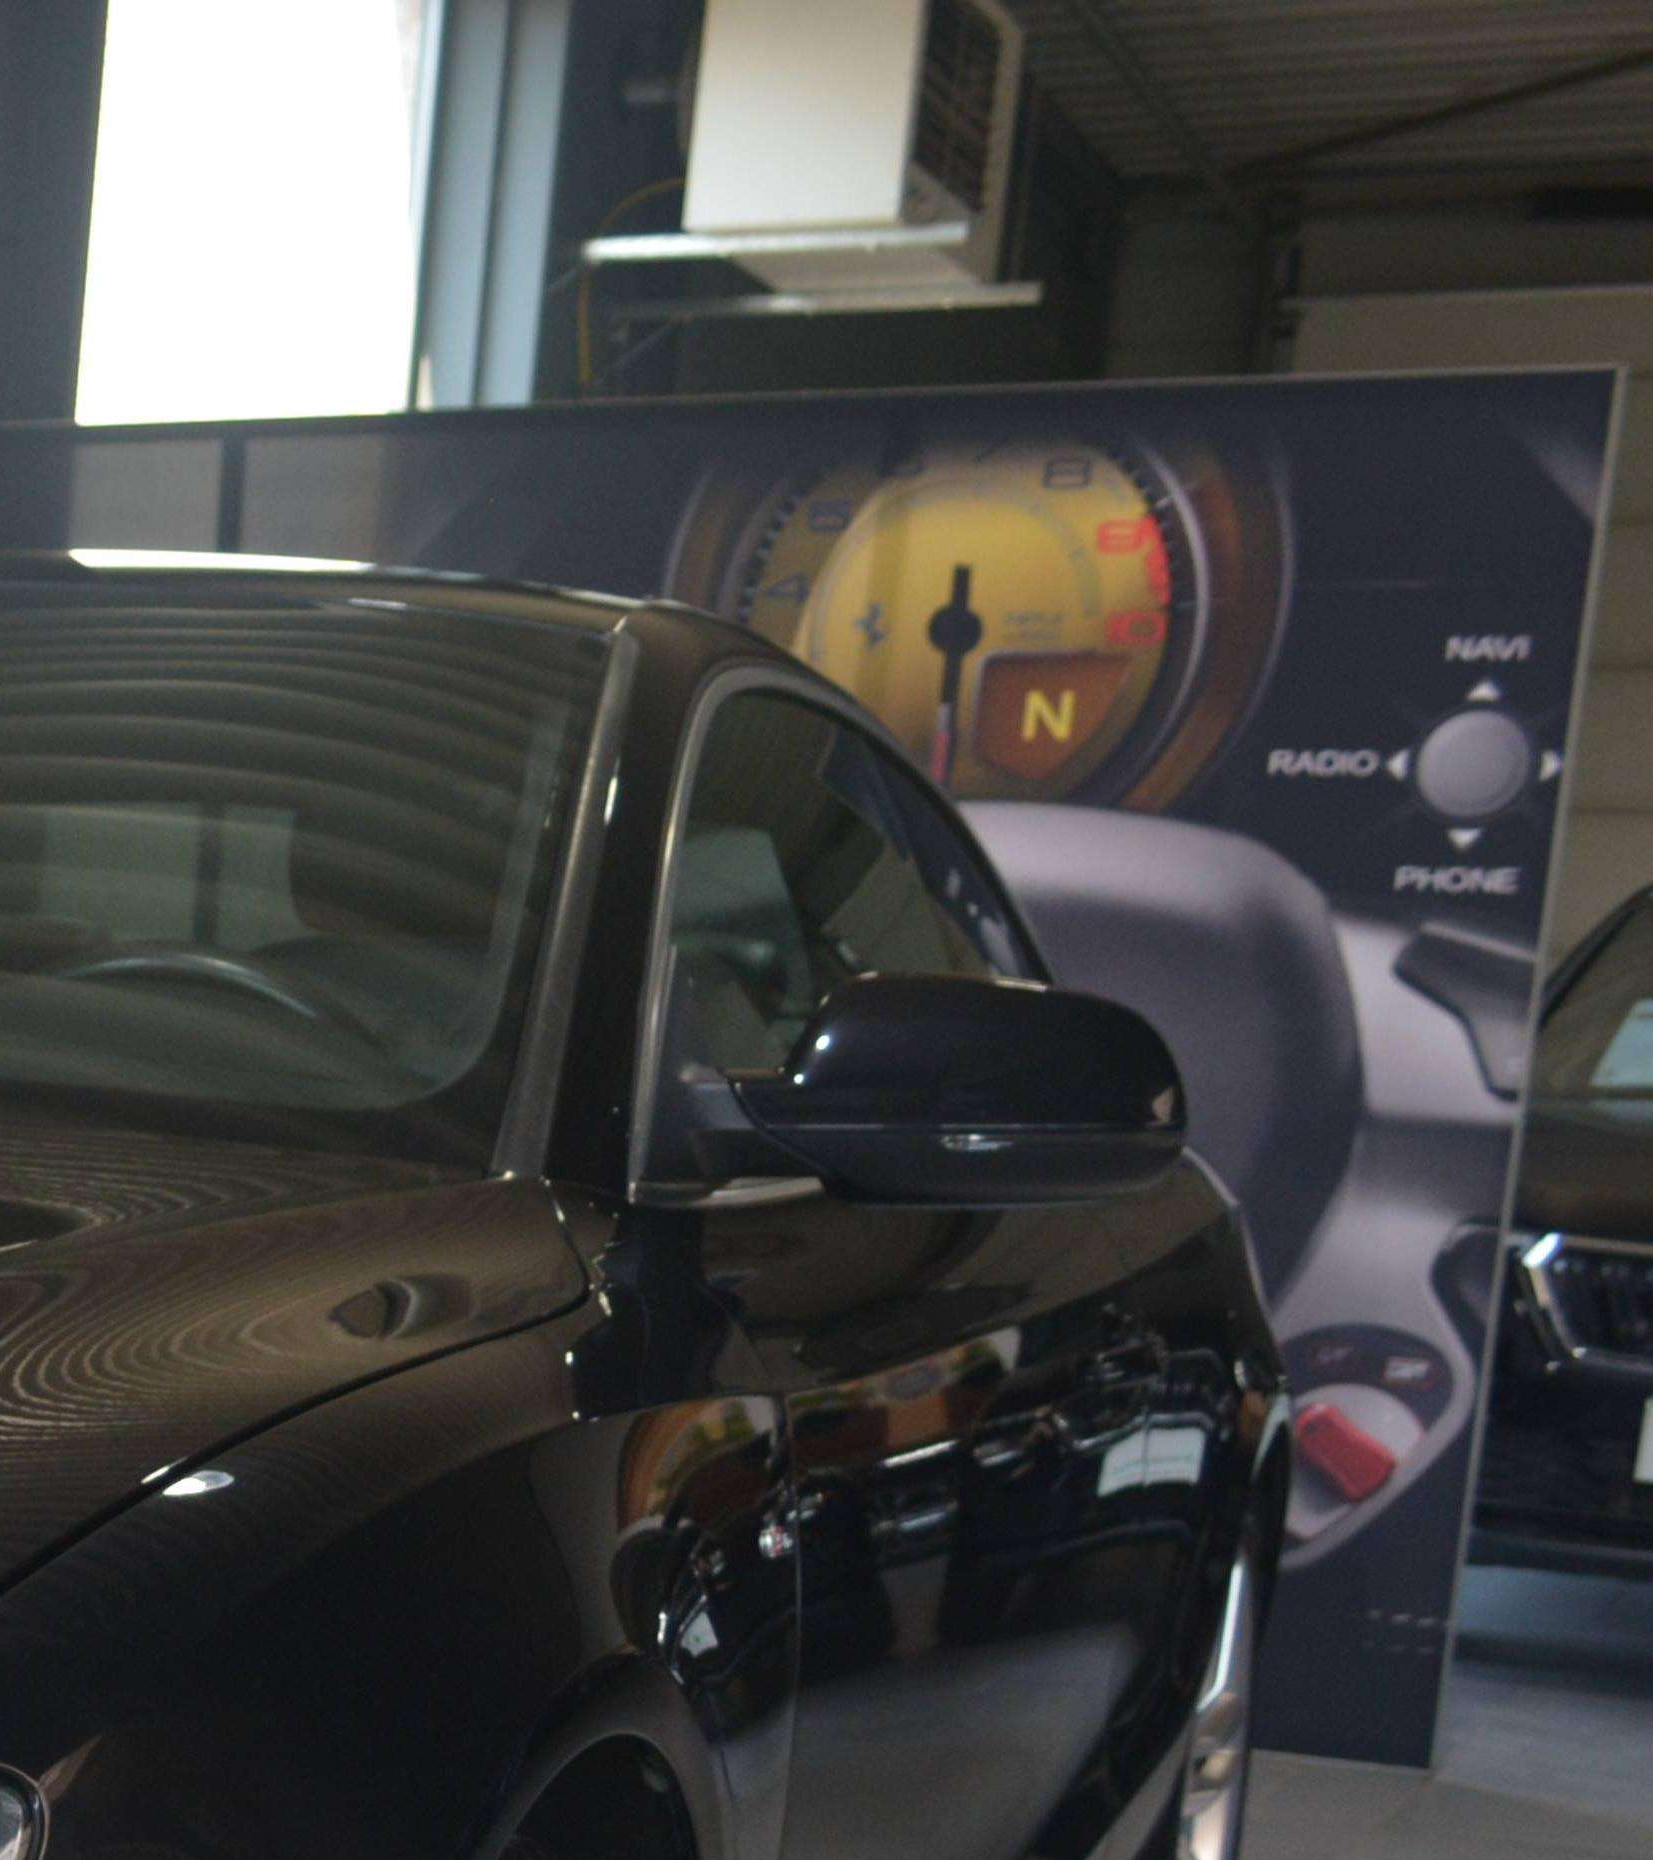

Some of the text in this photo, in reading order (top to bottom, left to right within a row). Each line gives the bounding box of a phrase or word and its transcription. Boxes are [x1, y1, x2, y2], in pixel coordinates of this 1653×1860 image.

[1445, 634, 1532, 661] NAVI
[1021, 688, 1076, 742] N
[1266, 748, 1381, 778] RADIO
[1394, 864, 1522, 895] PHONE
